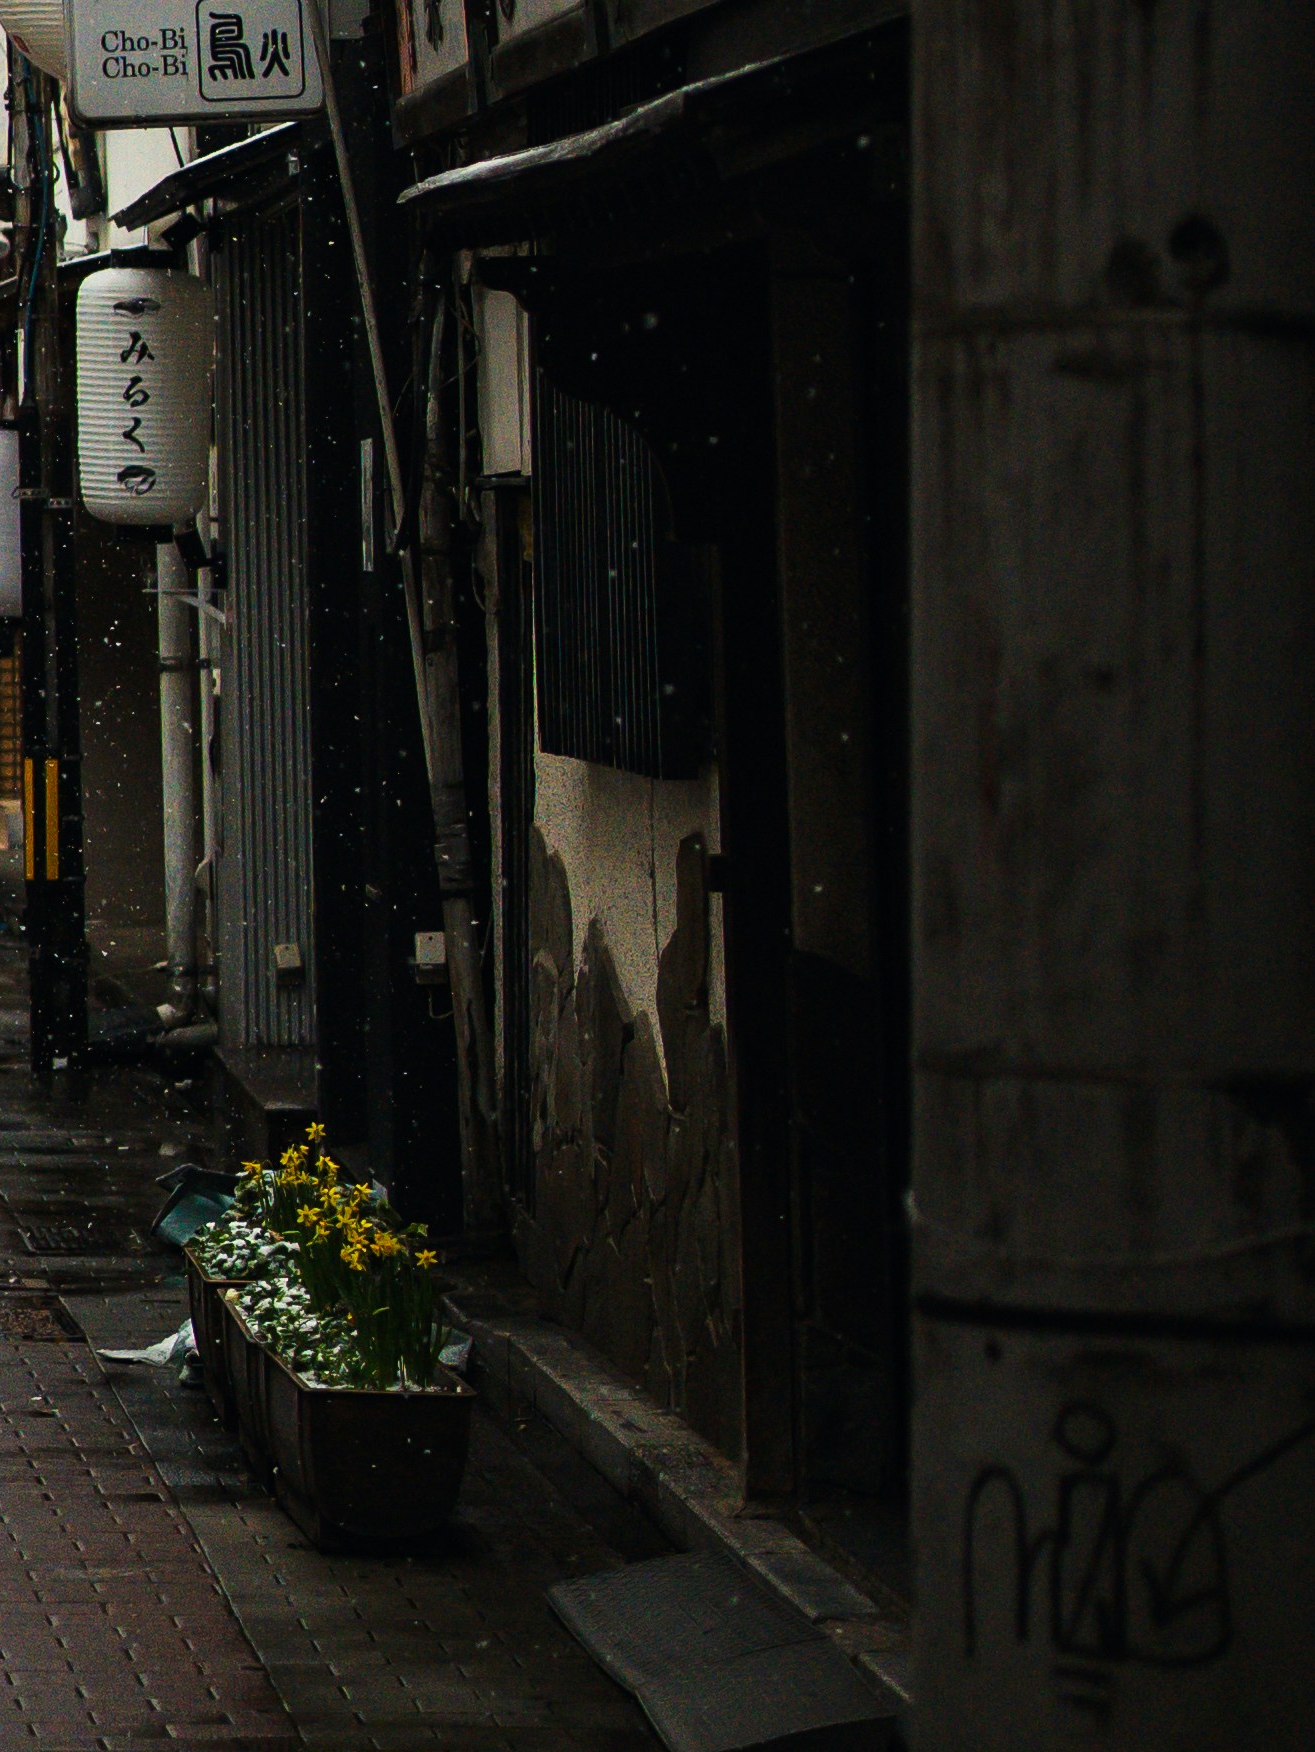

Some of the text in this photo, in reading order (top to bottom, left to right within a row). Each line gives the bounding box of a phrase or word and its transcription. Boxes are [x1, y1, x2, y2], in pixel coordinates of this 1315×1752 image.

[100, 28, 188, 54] Cho-Bi
[101, 54, 190, 80] Cho-Bi
[119, 330, 156, 454] みるく
